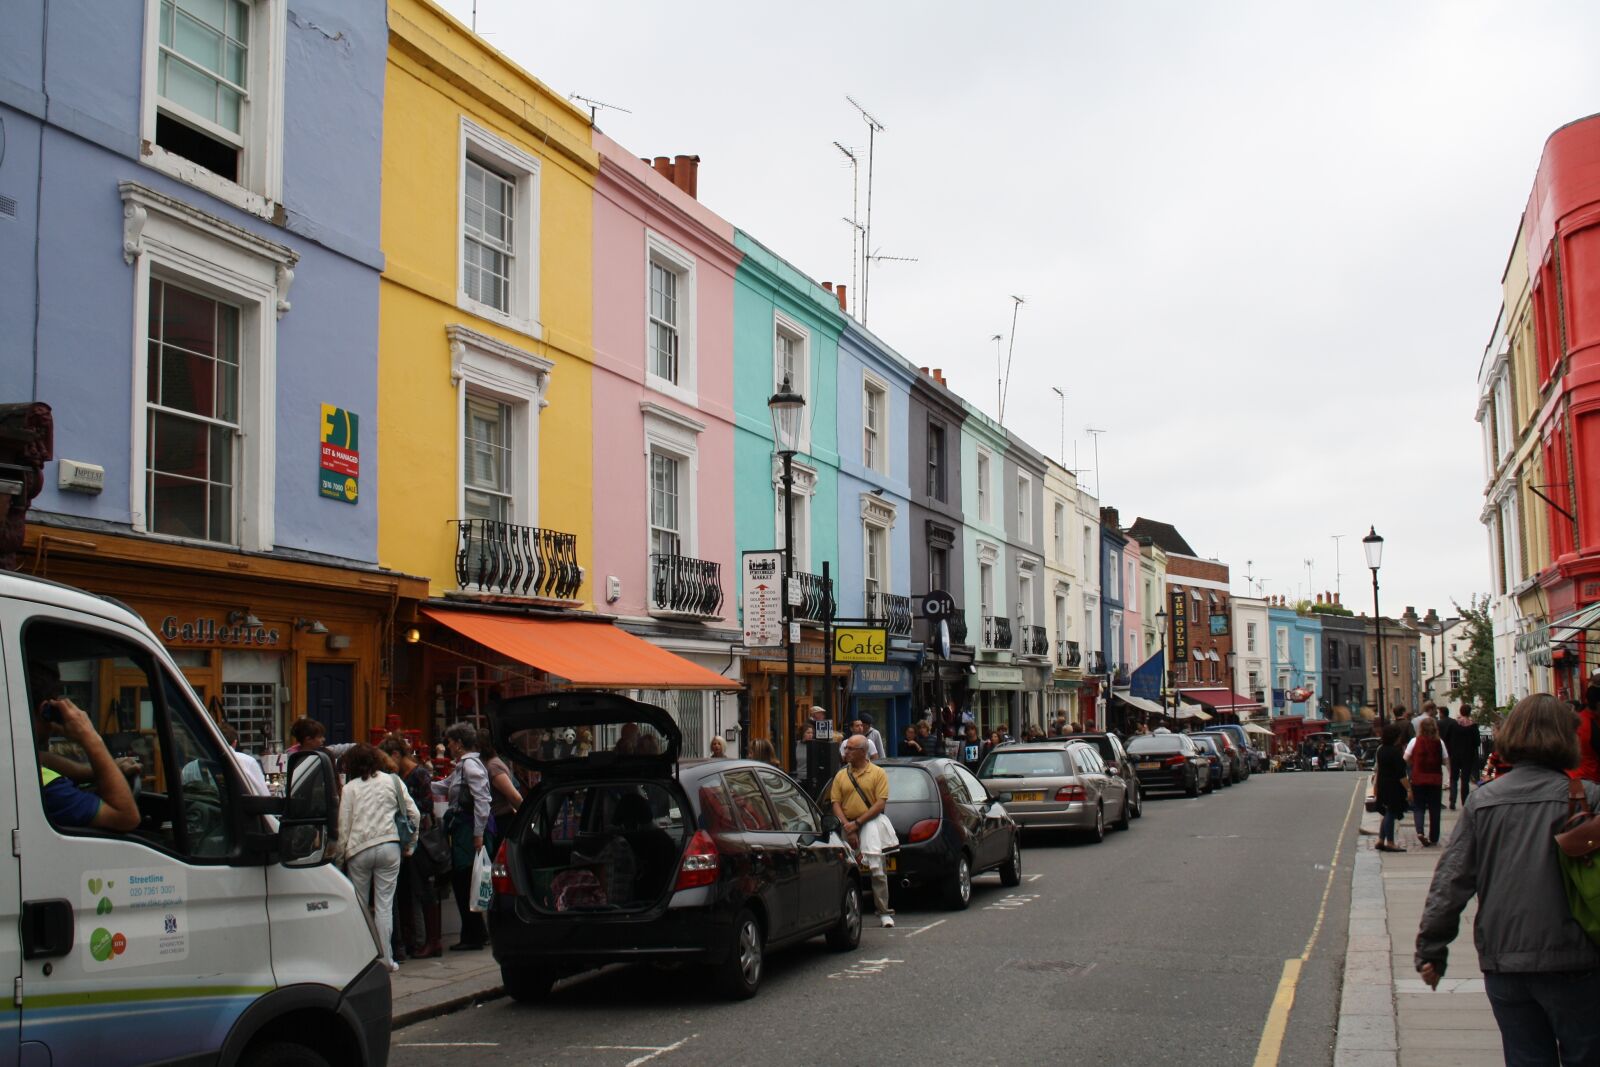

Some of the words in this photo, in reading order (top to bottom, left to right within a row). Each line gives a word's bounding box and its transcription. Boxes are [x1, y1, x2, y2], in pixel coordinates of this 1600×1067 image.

[323, 447, 331, 456] LET
[336, 451, 359, 464] MANAGED
[926, 599, 951, 614] Oi!
[1174, 597, 1184, 615] THE
[160, 615, 280, 645] Galleries
[1176, 620, 1185, 646] GOLD
[837, 633, 884, 655] Café
[129, 875, 164, 884] Streetline
[129, 887, 143, 897] 020
